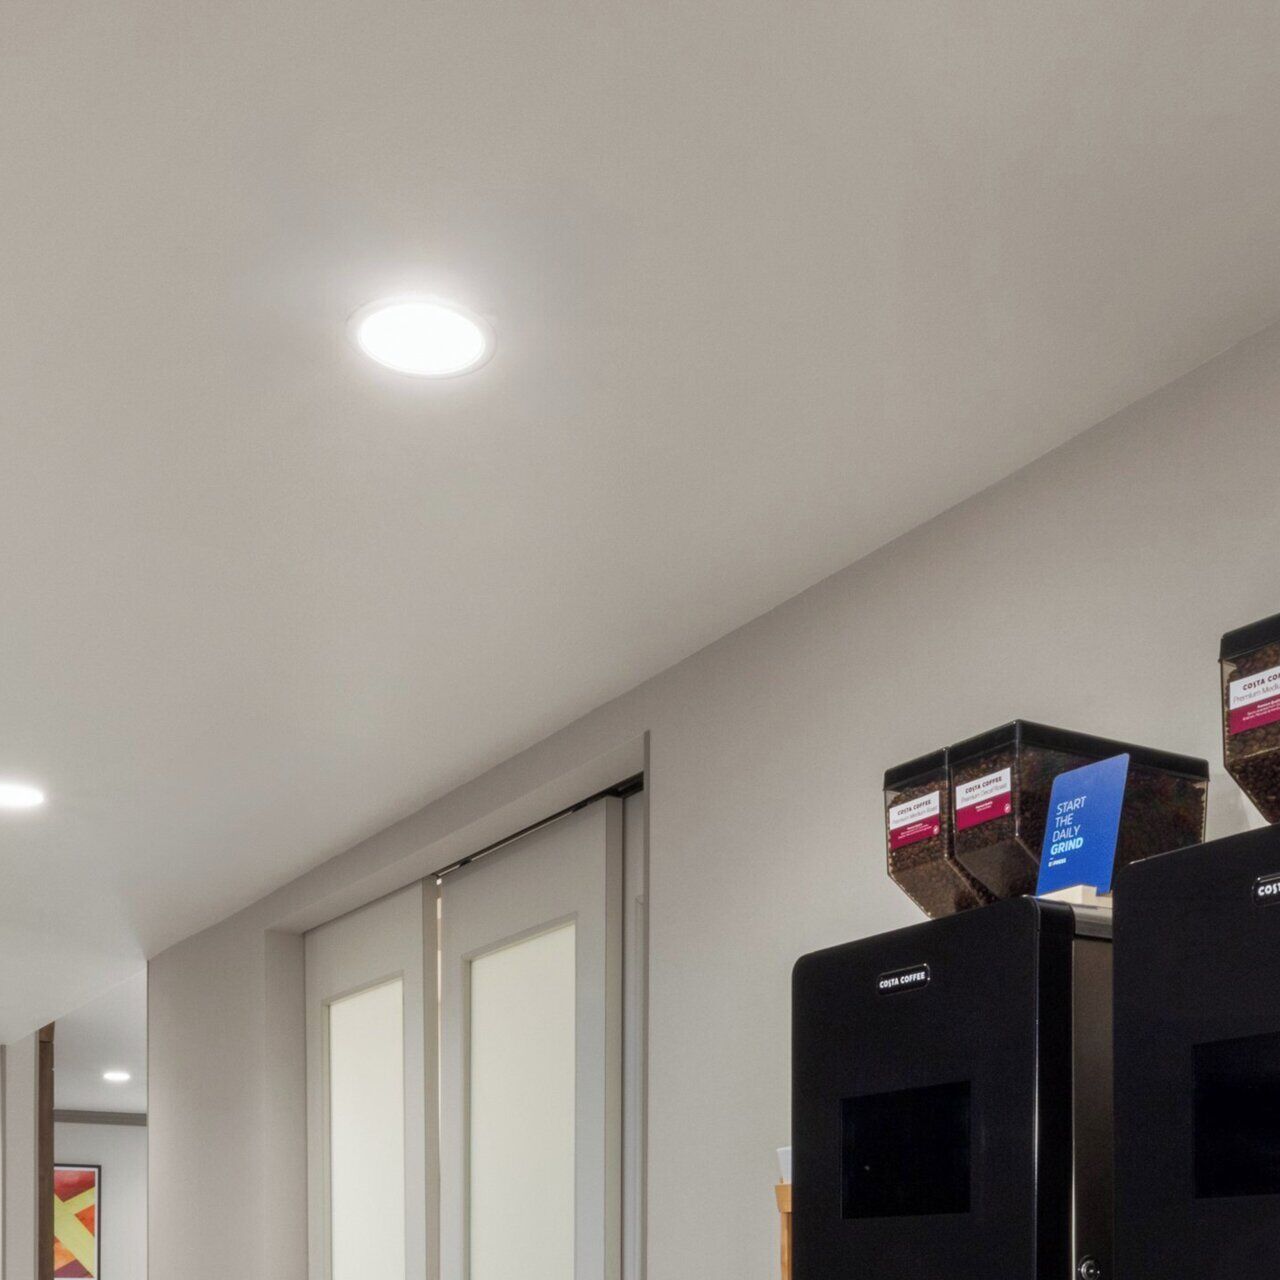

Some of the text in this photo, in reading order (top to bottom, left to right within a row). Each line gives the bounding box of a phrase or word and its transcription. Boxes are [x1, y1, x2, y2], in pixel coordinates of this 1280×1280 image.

[1242, 678, 1266, 691] COSTA
[1232, 690, 1261, 703] Premium
[965, 776, 1002, 794] COSTA COFFEE
[897, 799, 932, 816] COSTA COFFEE
[1056, 795, 1087, 816] START
[1055, 813, 1074, 828] THE
[1052, 824, 1081, 843] DAILY
[1050, 837, 1084, 855] GRIND
[879, 971, 926, 989] COSTA COFFEE
